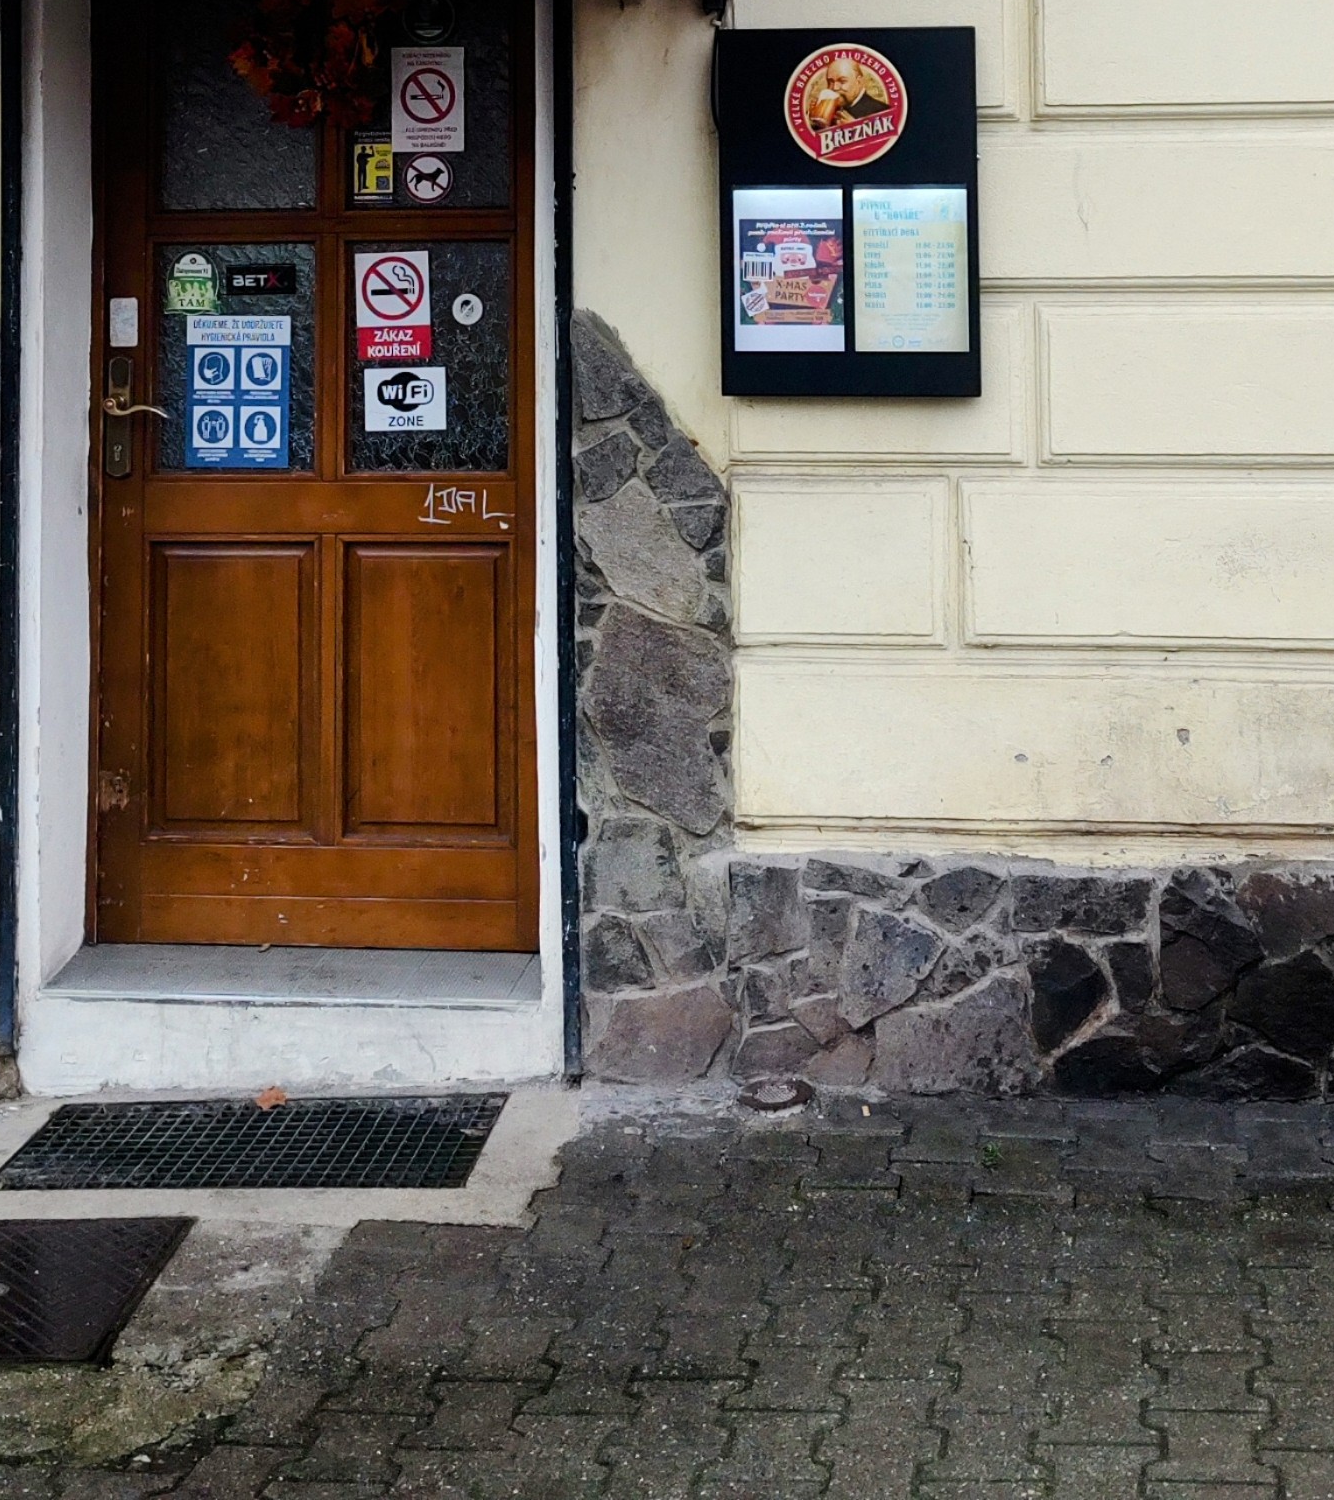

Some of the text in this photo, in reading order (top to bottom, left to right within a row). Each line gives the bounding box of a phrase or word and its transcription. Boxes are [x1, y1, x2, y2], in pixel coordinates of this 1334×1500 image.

[796, 55, 830, 89] BŘEZNO
[834, 51, 886, 75] ZALOŽENO
[791, 92, 803, 126] VELKÉ
[819, 115, 895, 155] BŘEZŇÁK
[374, 328, 413, 343] ZÁKAZ
[367, 341, 421, 358] KOUŘENÍ
[388, 416, 424, 427] ZONE
